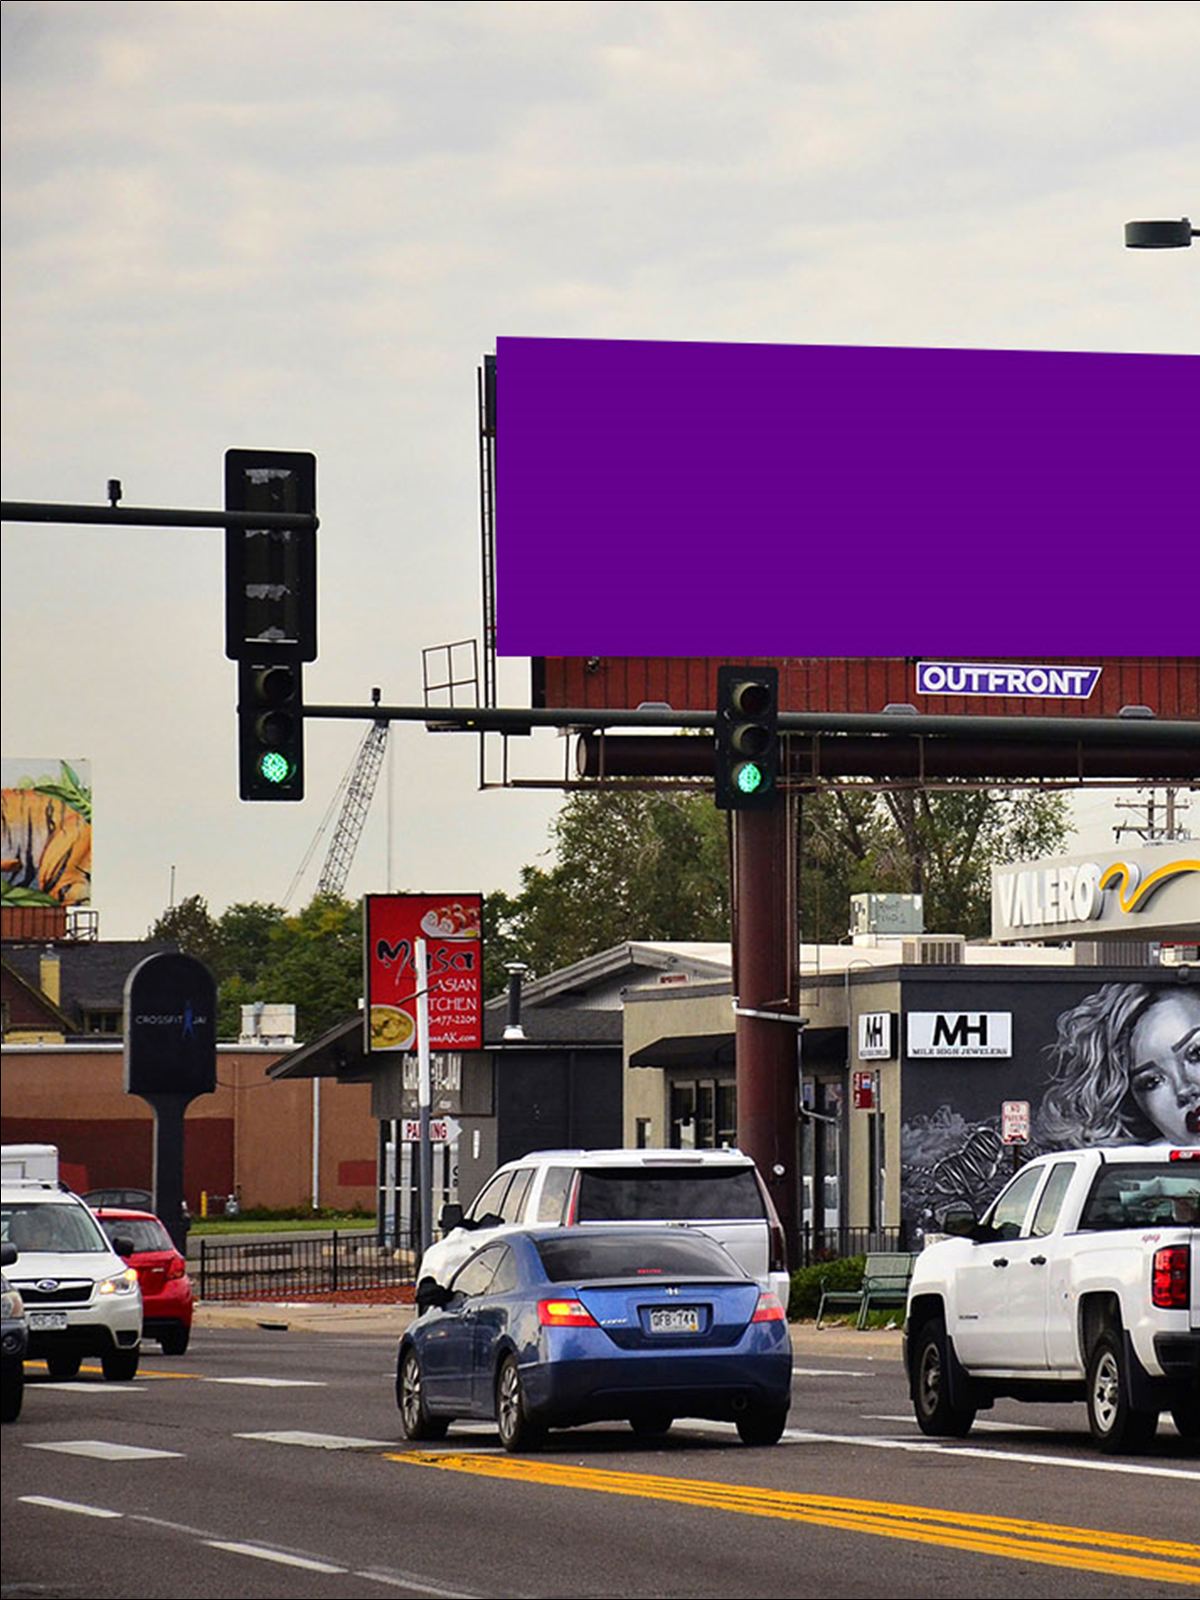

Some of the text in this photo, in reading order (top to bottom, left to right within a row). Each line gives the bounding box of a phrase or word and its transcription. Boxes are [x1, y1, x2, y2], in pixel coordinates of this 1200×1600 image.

[922, 666, 1091, 694] OUTFRONT
[1000, 862, 1102, 928] VALERO
[434, 978, 477, 991] ASIAN
[428, 997, 477, 1010] TCHEN
[135, 1015, 183, 1025] CROSSFIT
[932, 1015, 988, 1046] MH
[865, 1016, 883, 1048] MH
[406, 1122, 447, 1139] PAING
